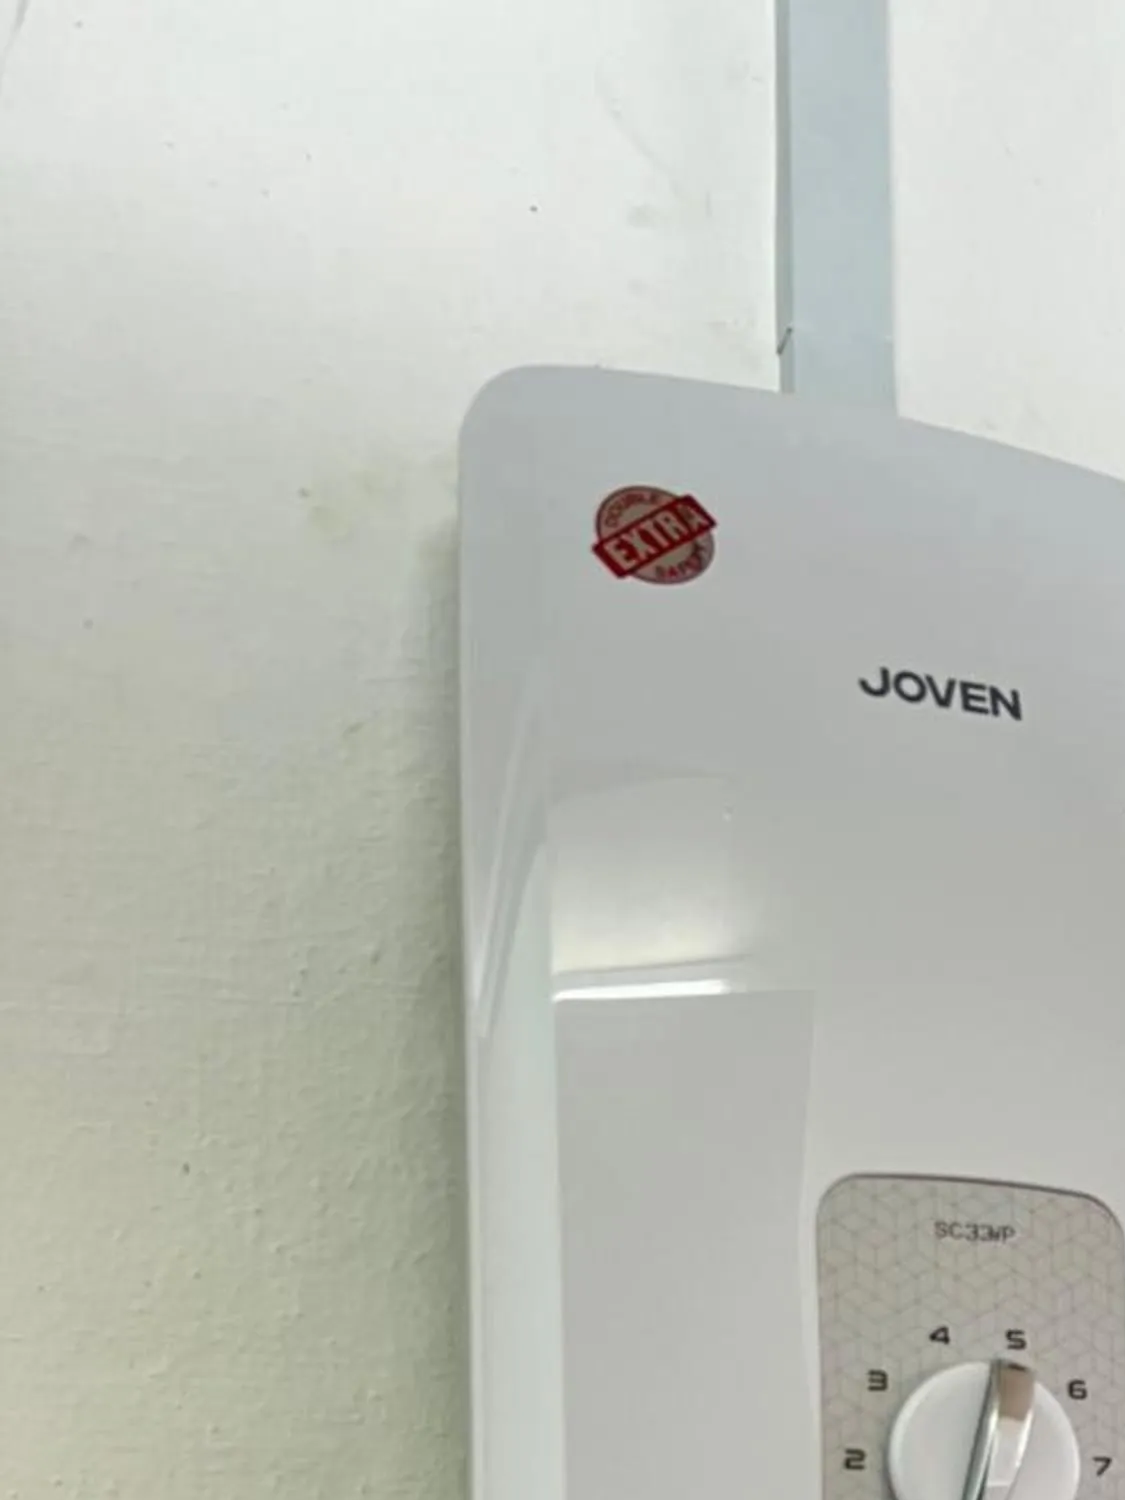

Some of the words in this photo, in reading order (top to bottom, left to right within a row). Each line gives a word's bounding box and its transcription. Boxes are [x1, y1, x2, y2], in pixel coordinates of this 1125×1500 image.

[603, 503, 709, 571] EXTRA
[858, 666, 1022, 721] JOVEN
[929, 1326, 951, 1345] 4
[1005, 1329, 1027, 1350] 5
[868, 1369, 888, 1391] 3
[1068, 1379, 1088, 1400] 6
[844, 1448, 866, 1470] 2
[1093, 1457, 1112, 1476] 7
